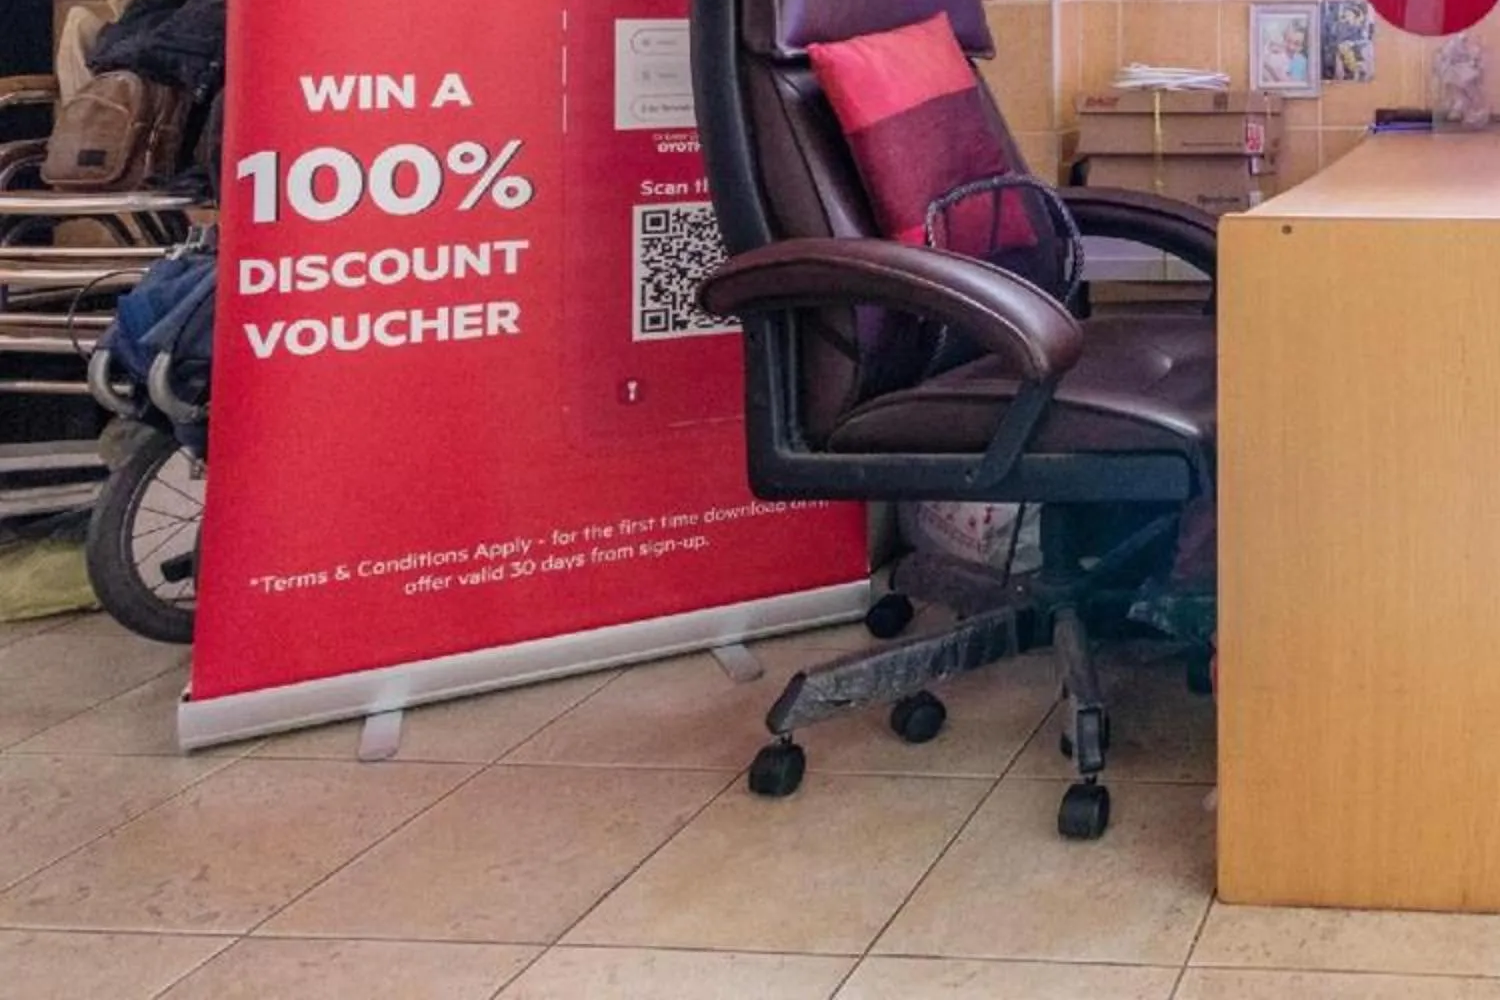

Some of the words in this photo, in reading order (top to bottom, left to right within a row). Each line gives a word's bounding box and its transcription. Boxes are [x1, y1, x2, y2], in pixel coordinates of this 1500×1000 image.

[300, 74, 414, 112] WIN
[431, 73, 473, 109] A
[236, 139, 536, 224] 100%
[640, 179, 689, 196] Scan
[238, 239, 530, 295] DISCOUNT
[243, 301, 521, 360] VOUCHER
[335, 564, 351, 582] &
[356, 547, 469, 578] Conditions
[473, 535, 533, 560] Apply
[551, 527, 578, 546] for
[584, 524, 614, 541] the
[619, 516, 656, 536] first
[660, 511, 700, 530] time
[404, 575, 452, 597] offer
[458, 565, 505, 586] valid
[509, 561, 534, 579] 30
[541, 554, 586, 573] days
[591, 544, 634, 563] from
[639, 532, 711, 557] sign-up.
